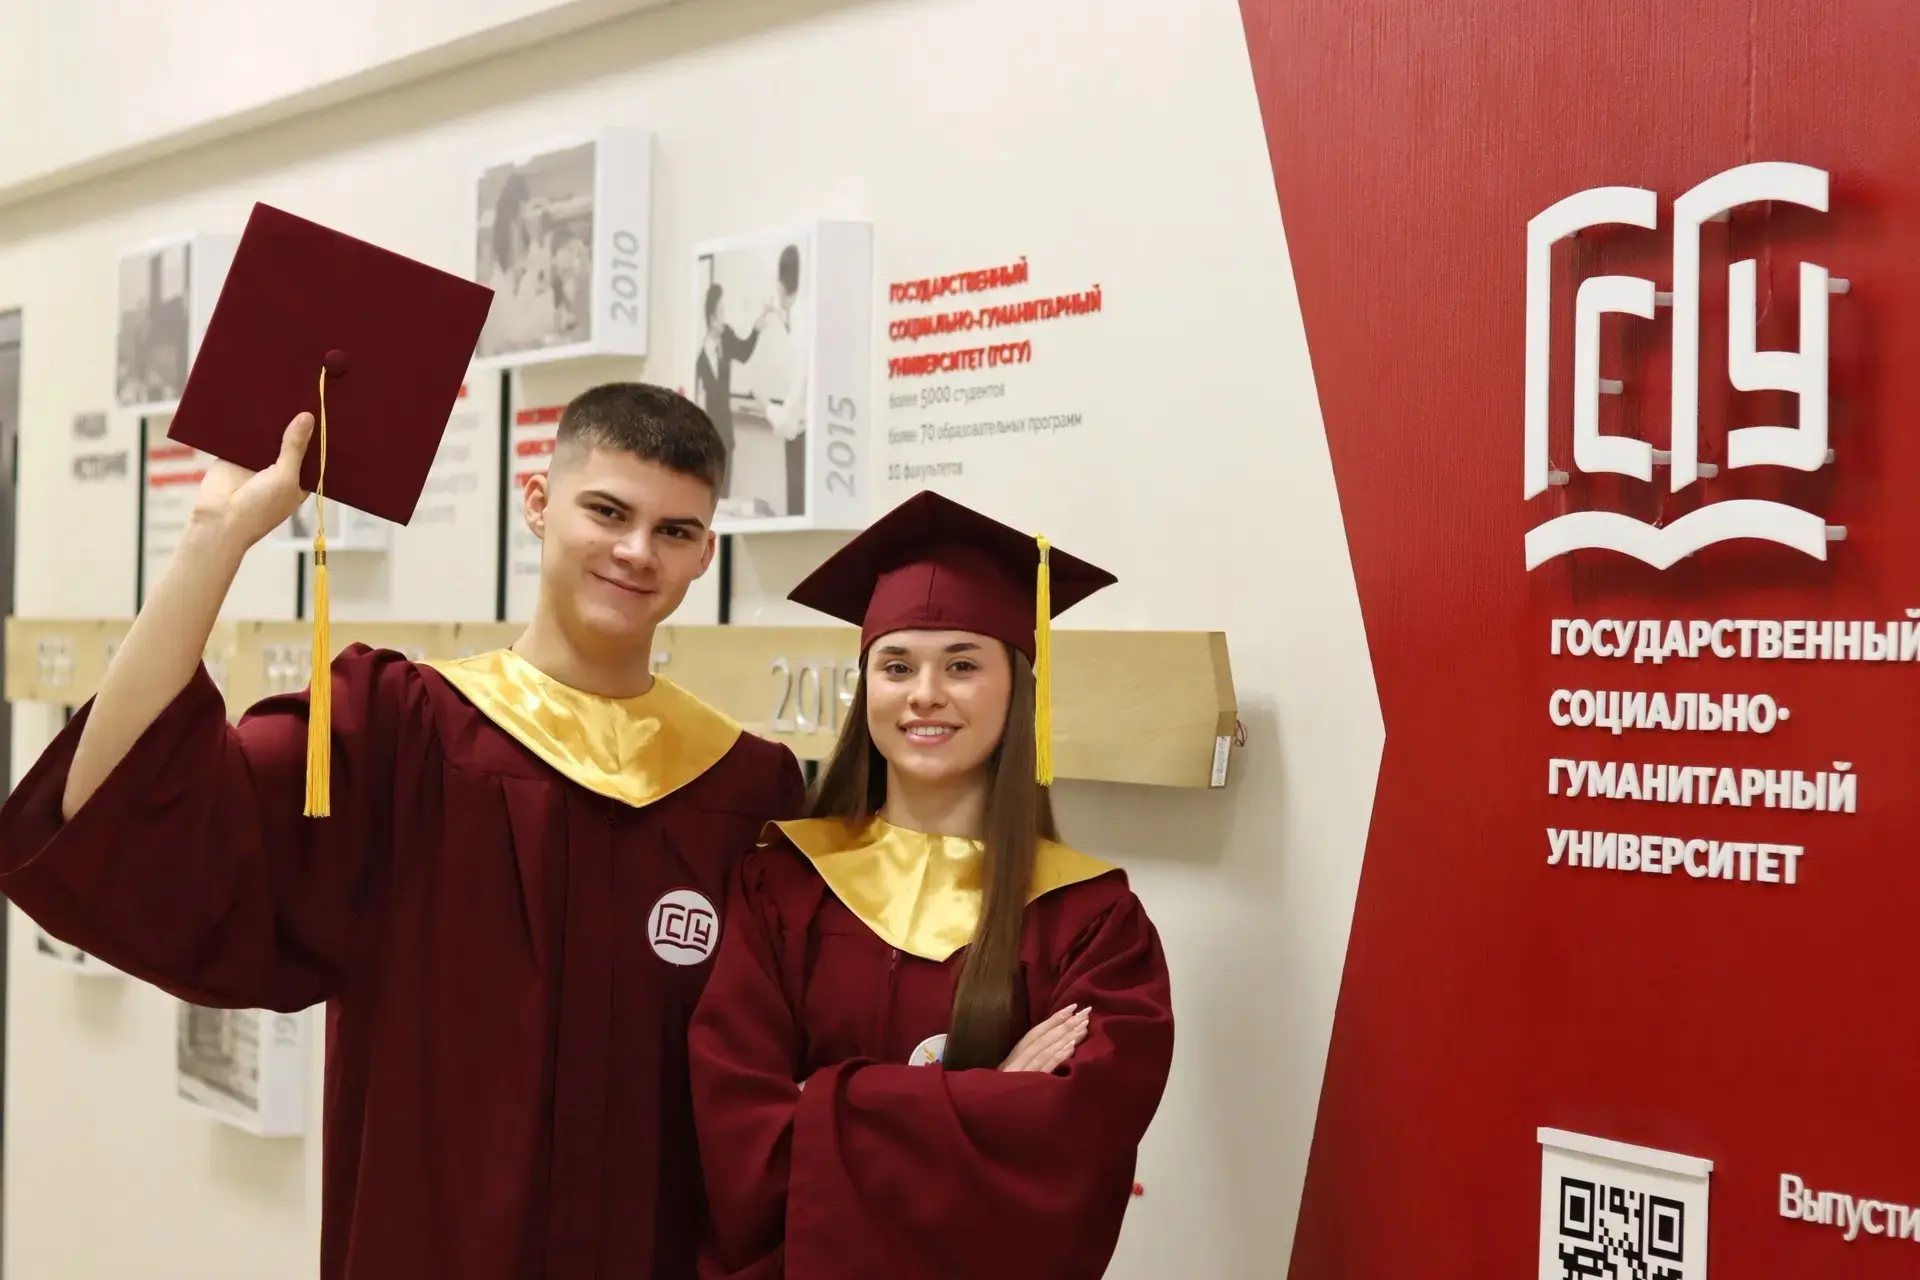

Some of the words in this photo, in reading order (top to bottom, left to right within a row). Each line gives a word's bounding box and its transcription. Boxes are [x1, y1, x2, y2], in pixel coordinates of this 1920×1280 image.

[610, 229, 639, 325] 2010
[889, 255, 1028, 303] ГОСУДАРСТВЕННЫЙ
[888, 284, 1102, 341] СОЦИАЛЬНО-ГУМАНИТАРНЫЙ
[888, 348, 984, 379] УНИВЕРСИТЕТ
[920, 385, 951, 410] 5000
[826, 395, 857, 497] 2015
[920, 423, 935, 445] 70
[937, 420, 1025, 443] образовательных
[1027, 412, 1083, 436] программ
[1550, 608, 1920, 664] ГОСУДАРСТВЕННЫЙ
[1548, 758, 1857, 814] ГУМАНИТАРНЫЙ
[1546, 827, 1804, 885] УНИВЕРСИТЕТ
